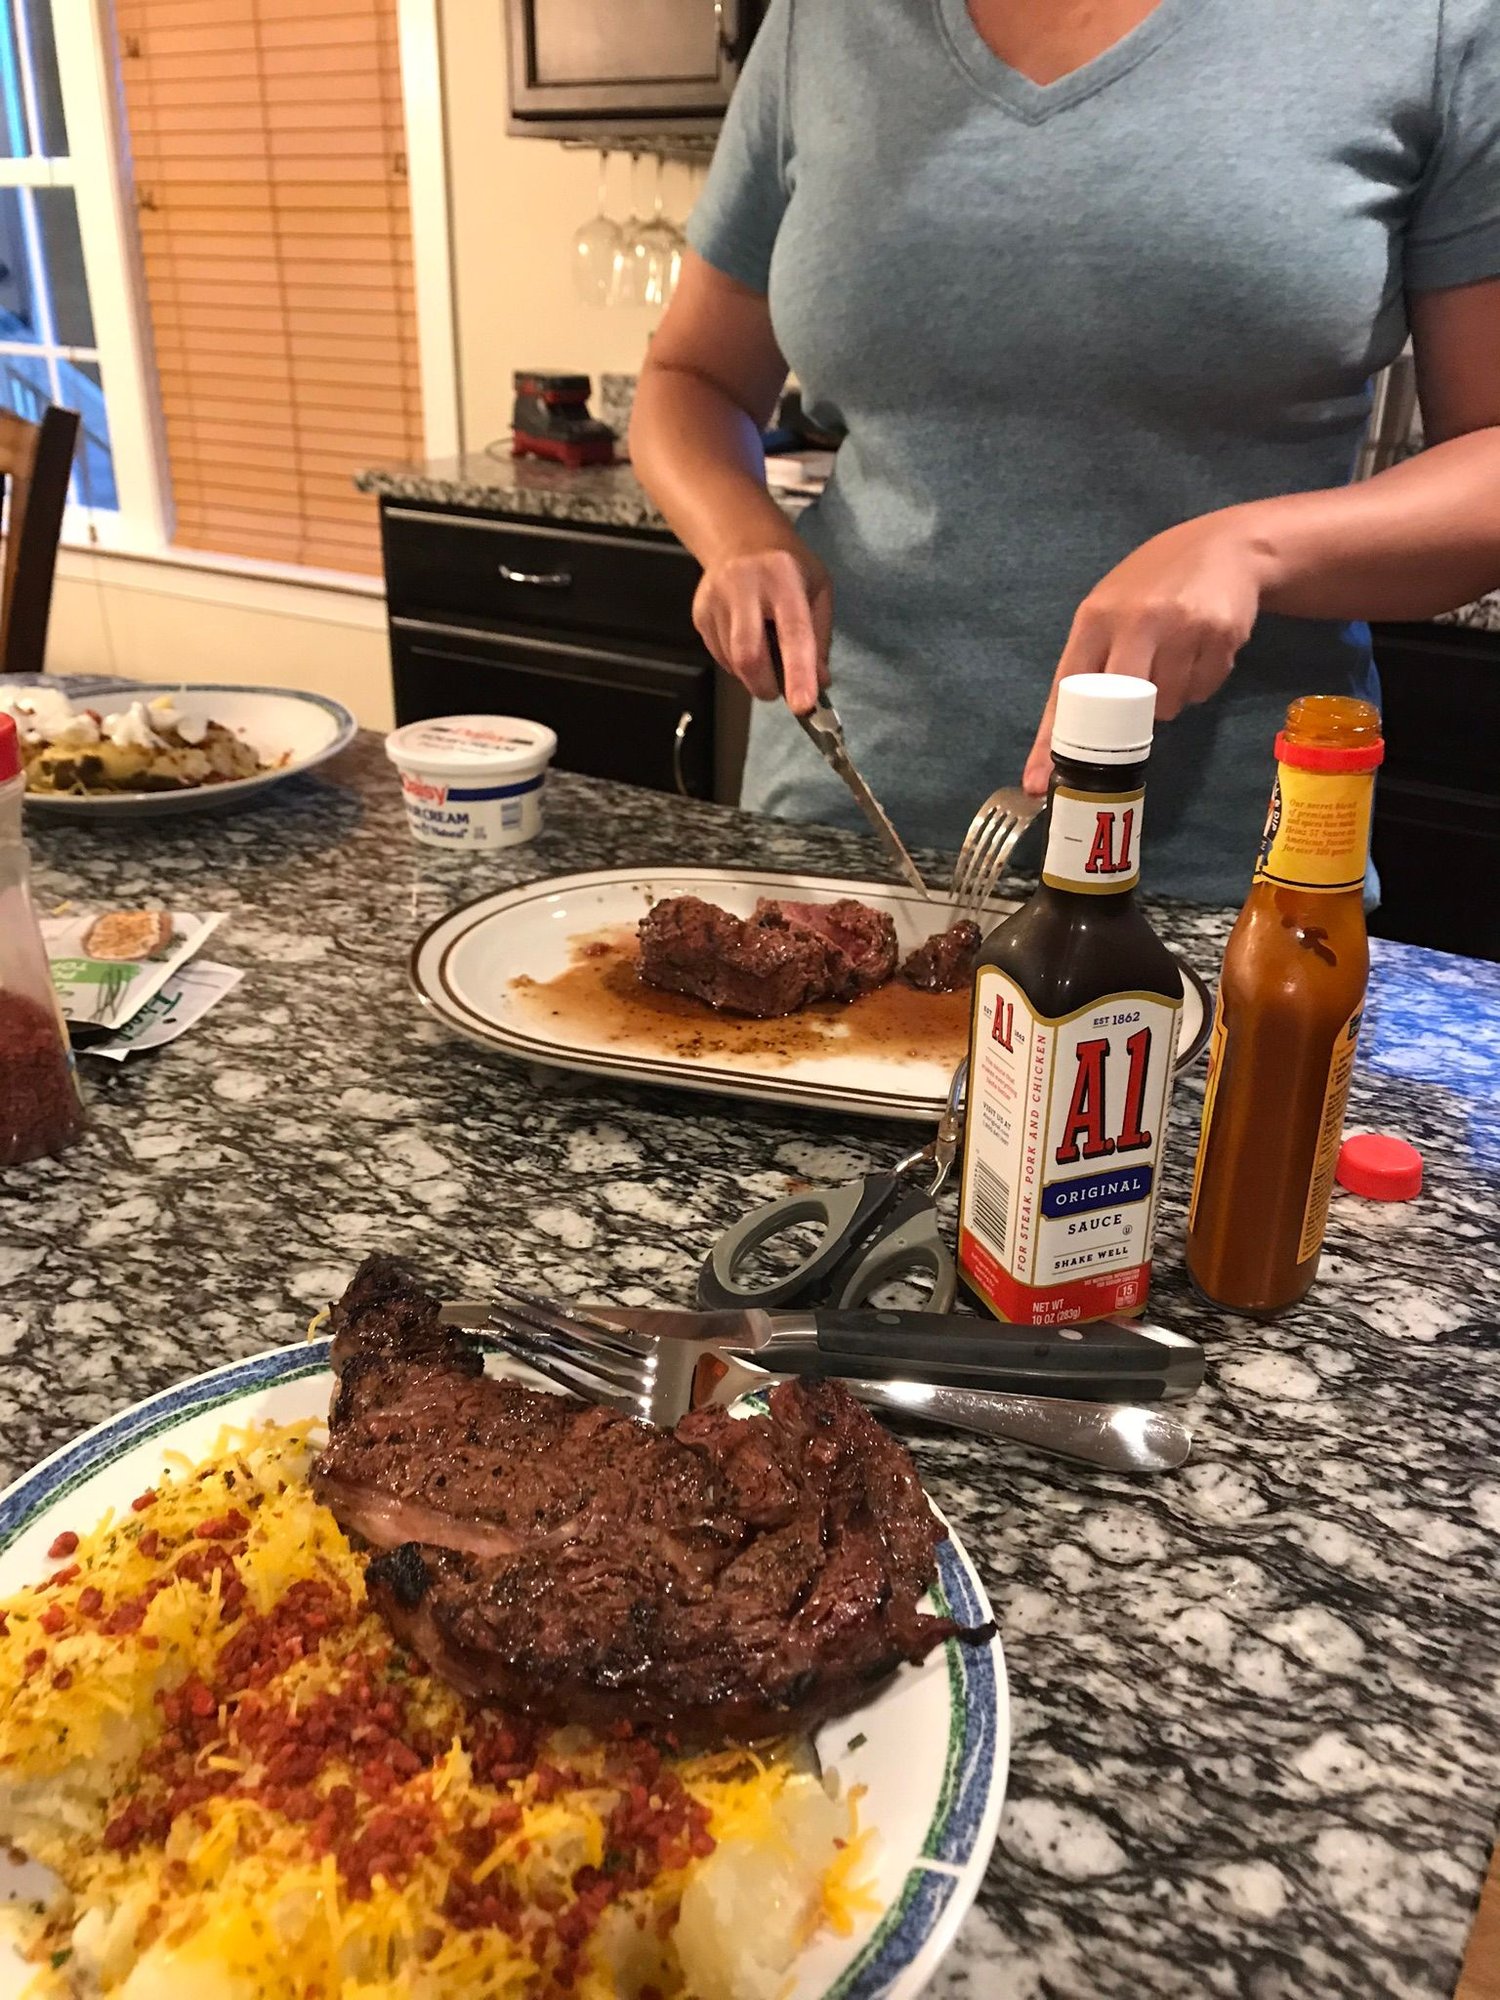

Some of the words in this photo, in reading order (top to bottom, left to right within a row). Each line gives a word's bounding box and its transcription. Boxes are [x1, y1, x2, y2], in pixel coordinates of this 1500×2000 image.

[423, 809, 470, 825] CREAM
[1093, 1017, 1110, 1026] EST
[1112, 1011, 1141, 1025] 1862
[1032, 1035, 1047, 1103] CHICKEN
[1004, 1120, 1011, 1131] AT
[1029, 1110, 1040, 1140] AND
[1025, 1145, 1037, 1185] PORK
[1055, 1178, 1141, 1206] ORIGINAL
[1021, 1192, 1033, 1240] STEAK,
[1067, 1213, 1122, 1236] SAUCE
[1017, 1245, 1028, 1273] FOR
[1054, 1253, 1093, 1270] SHAKE
[1098, 1246, 1129, 1260] WELL
[1122, 1284, 1133, 1296] 15
[1032, 1301, 1050, 1313] NET
[1051, 1298, 1064, 1310] WT
[1032, 1314, 1043, 1326] 10
[1044, 1312, 1056, 1325] OZ
